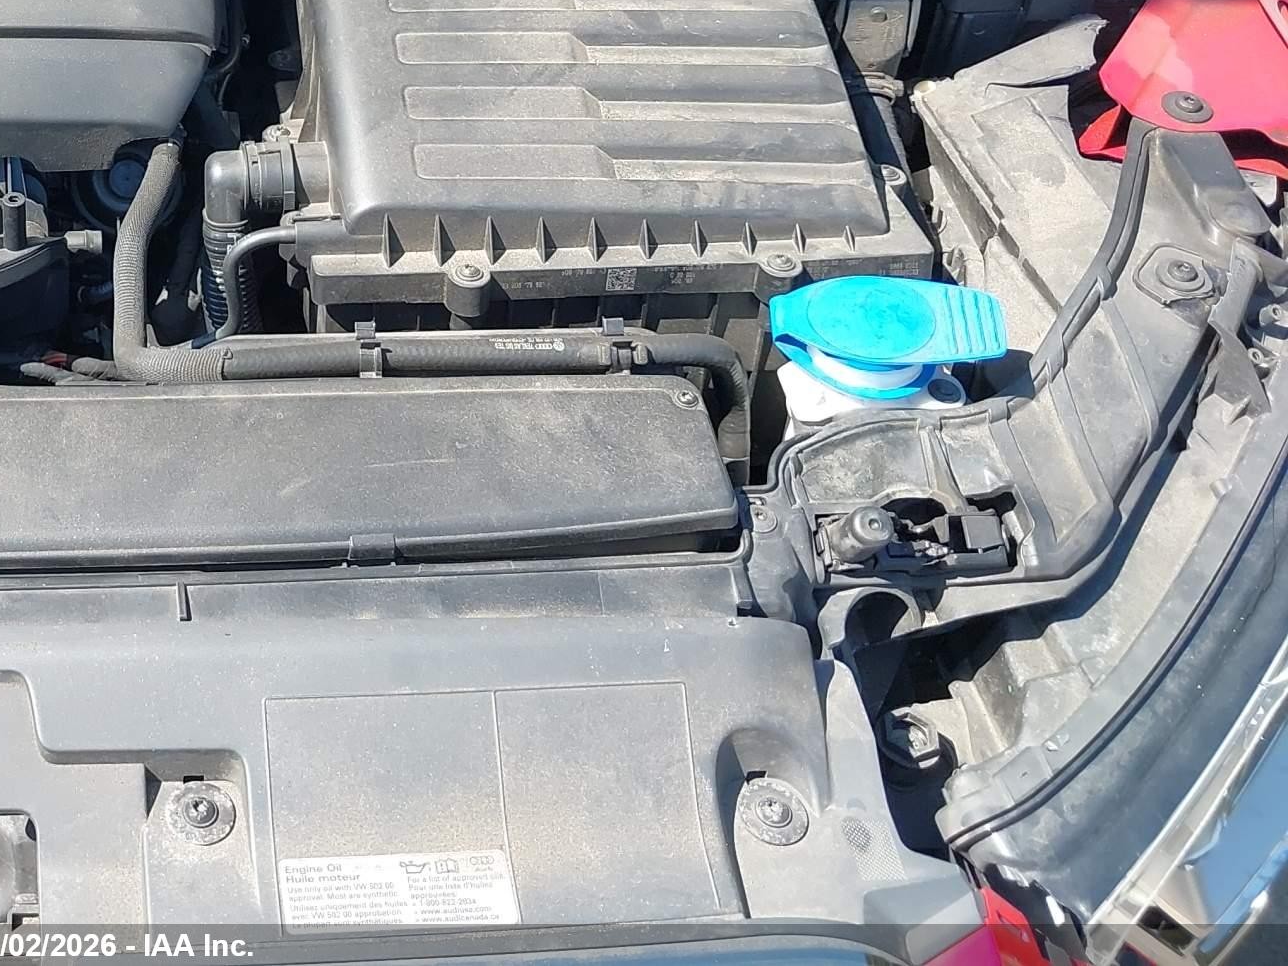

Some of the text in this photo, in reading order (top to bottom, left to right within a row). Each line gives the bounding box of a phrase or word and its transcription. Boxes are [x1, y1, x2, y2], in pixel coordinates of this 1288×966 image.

[285, 863, 343, 875] Engine Oil
[286, 874, 361, 884] Huile moteur
[353, 883, 367, 891] VW
